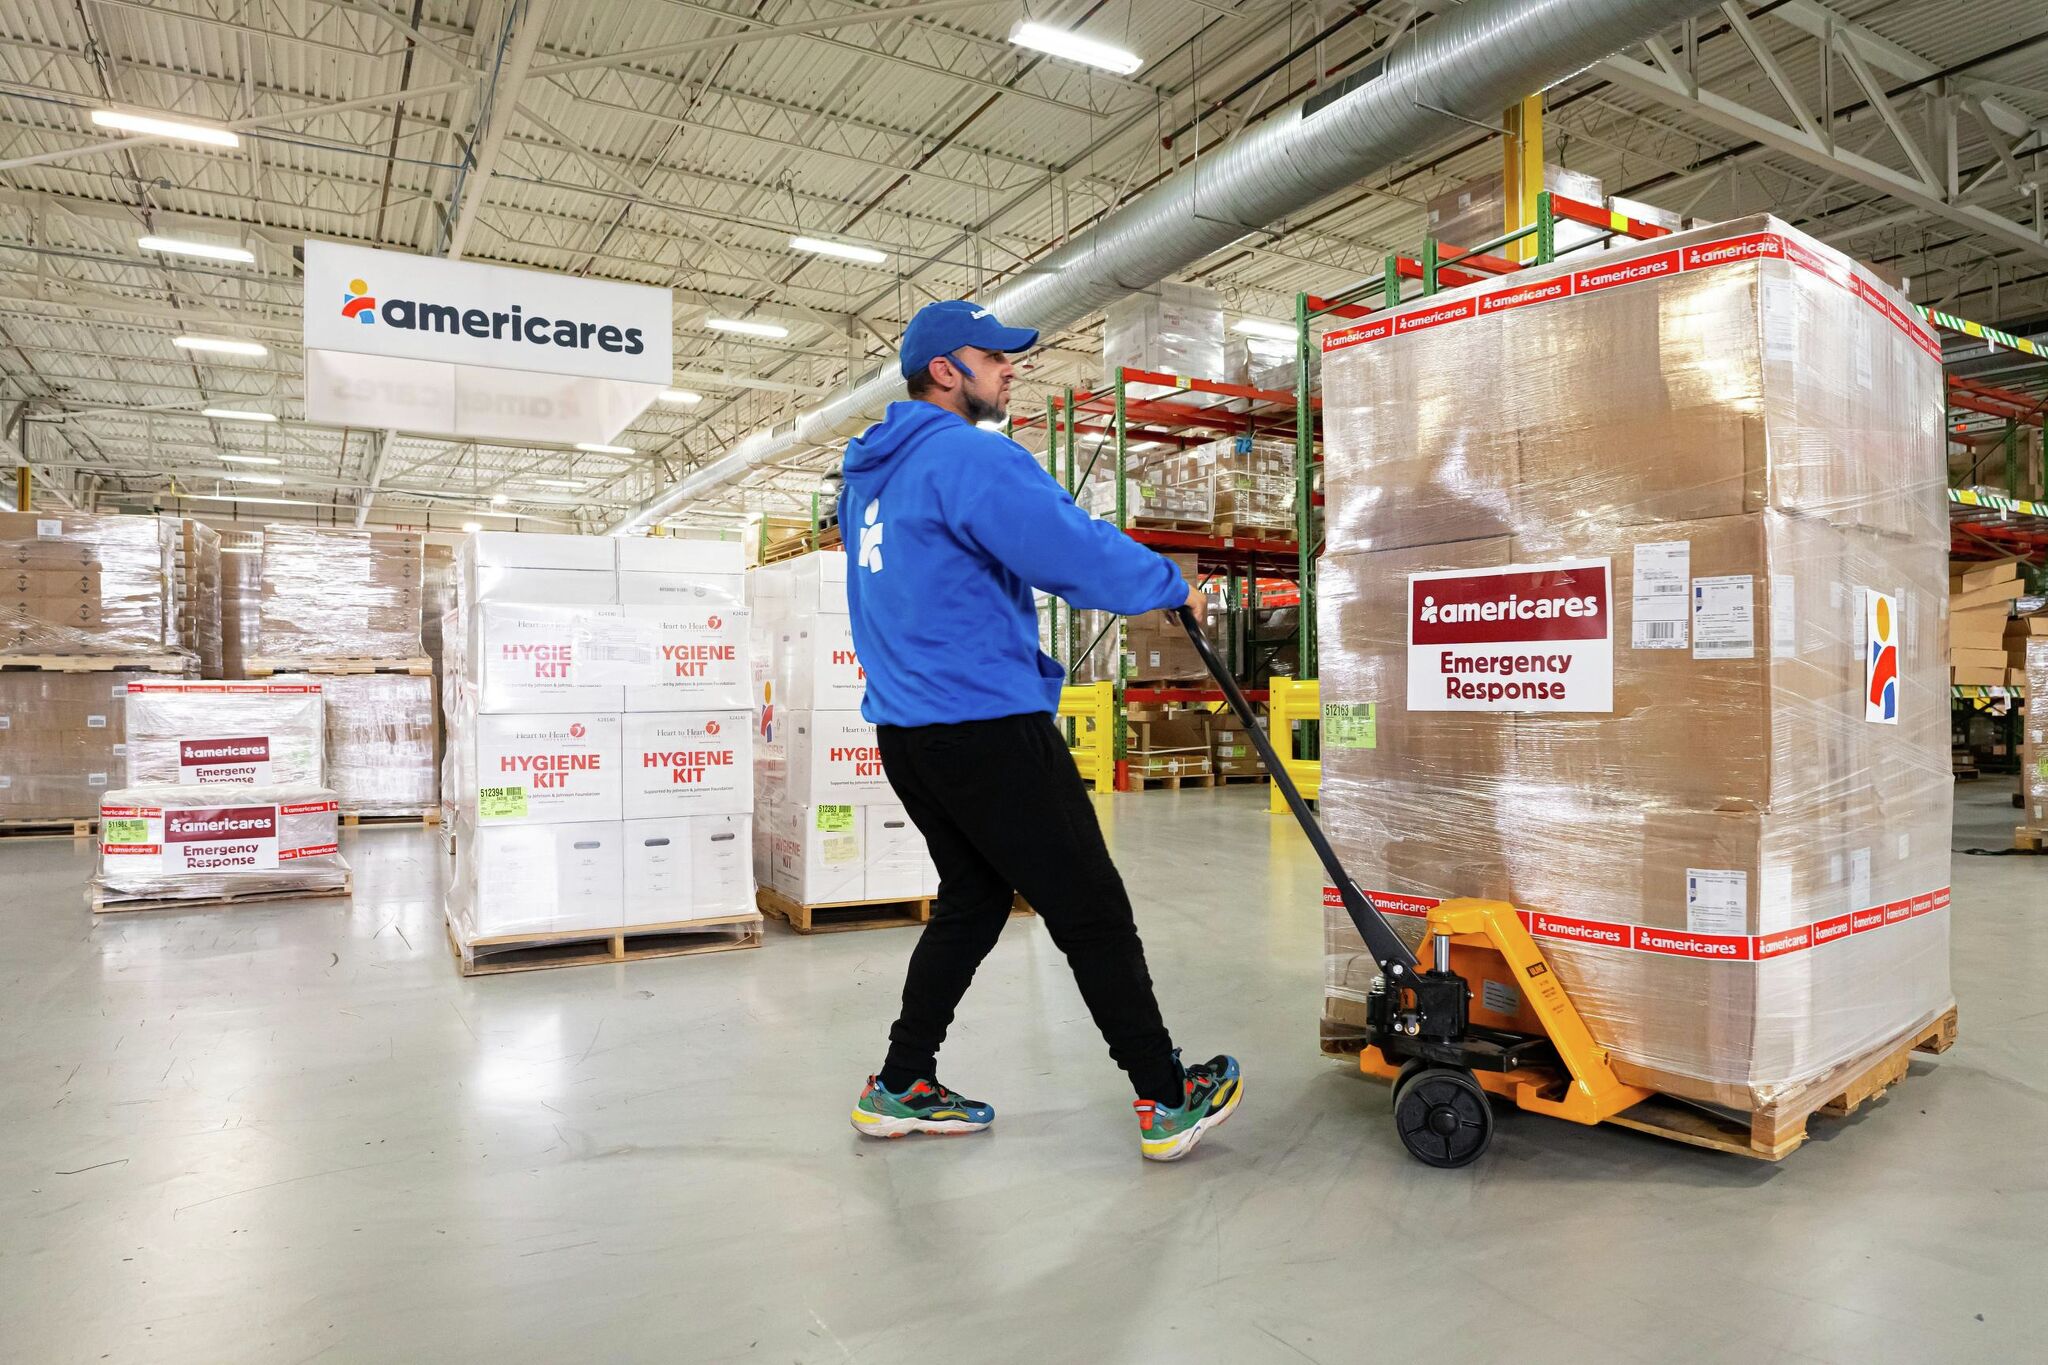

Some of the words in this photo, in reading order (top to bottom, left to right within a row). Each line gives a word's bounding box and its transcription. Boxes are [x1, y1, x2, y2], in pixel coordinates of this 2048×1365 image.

[1702, 241, 1778, 262] americares
[1590, 261, 1668, 286] americares
[1492, 283, 1561, 307] americares
[1408, 307, 1467, 328] americares
[382, 298, 644, 355] americares
[1333, 326, 1385, 347] americares
[1236, 439, 1252, 452] 72
[1439, 594, 1598, 624] americares
[503, 644, 572, 660] HYGIE
[662, 646, 735, 660] YGIENE
[536, 662, 571, 678] KIT
[676, 662, 708, 676] KIT
[1441, 651, 1572, 675] Emergency
[1446, 677, 1565, 702] Response
[1326, 704, 1348, 716] 512163
[195, 746, 265, 758] americares
[644, 750, 733, 767] HYGIENE
[830, 747, 882, 761] HYGIE
[501, 754, 600, 772] HYGIENE
[856, 762, 883, 776] KIT
[196, 767, 256, 777] Emergency
[534, 772, 569, 788] KIT
[674, 768, 705, 783] KIT
[480, 788, 503, 798] 512394
[182, 818, 271, 832] americares
[184, 844, 258, 856] Emergency
[187, 857, 255, 868] Response
[1857, 914, 1882, 928] americares
[1547, 923, 1620, 942] americares
[1820, 922, 1847, 938] americares
[1651, 937, 1736, 955] americares
[1766, 934, 1807, 953] americares
